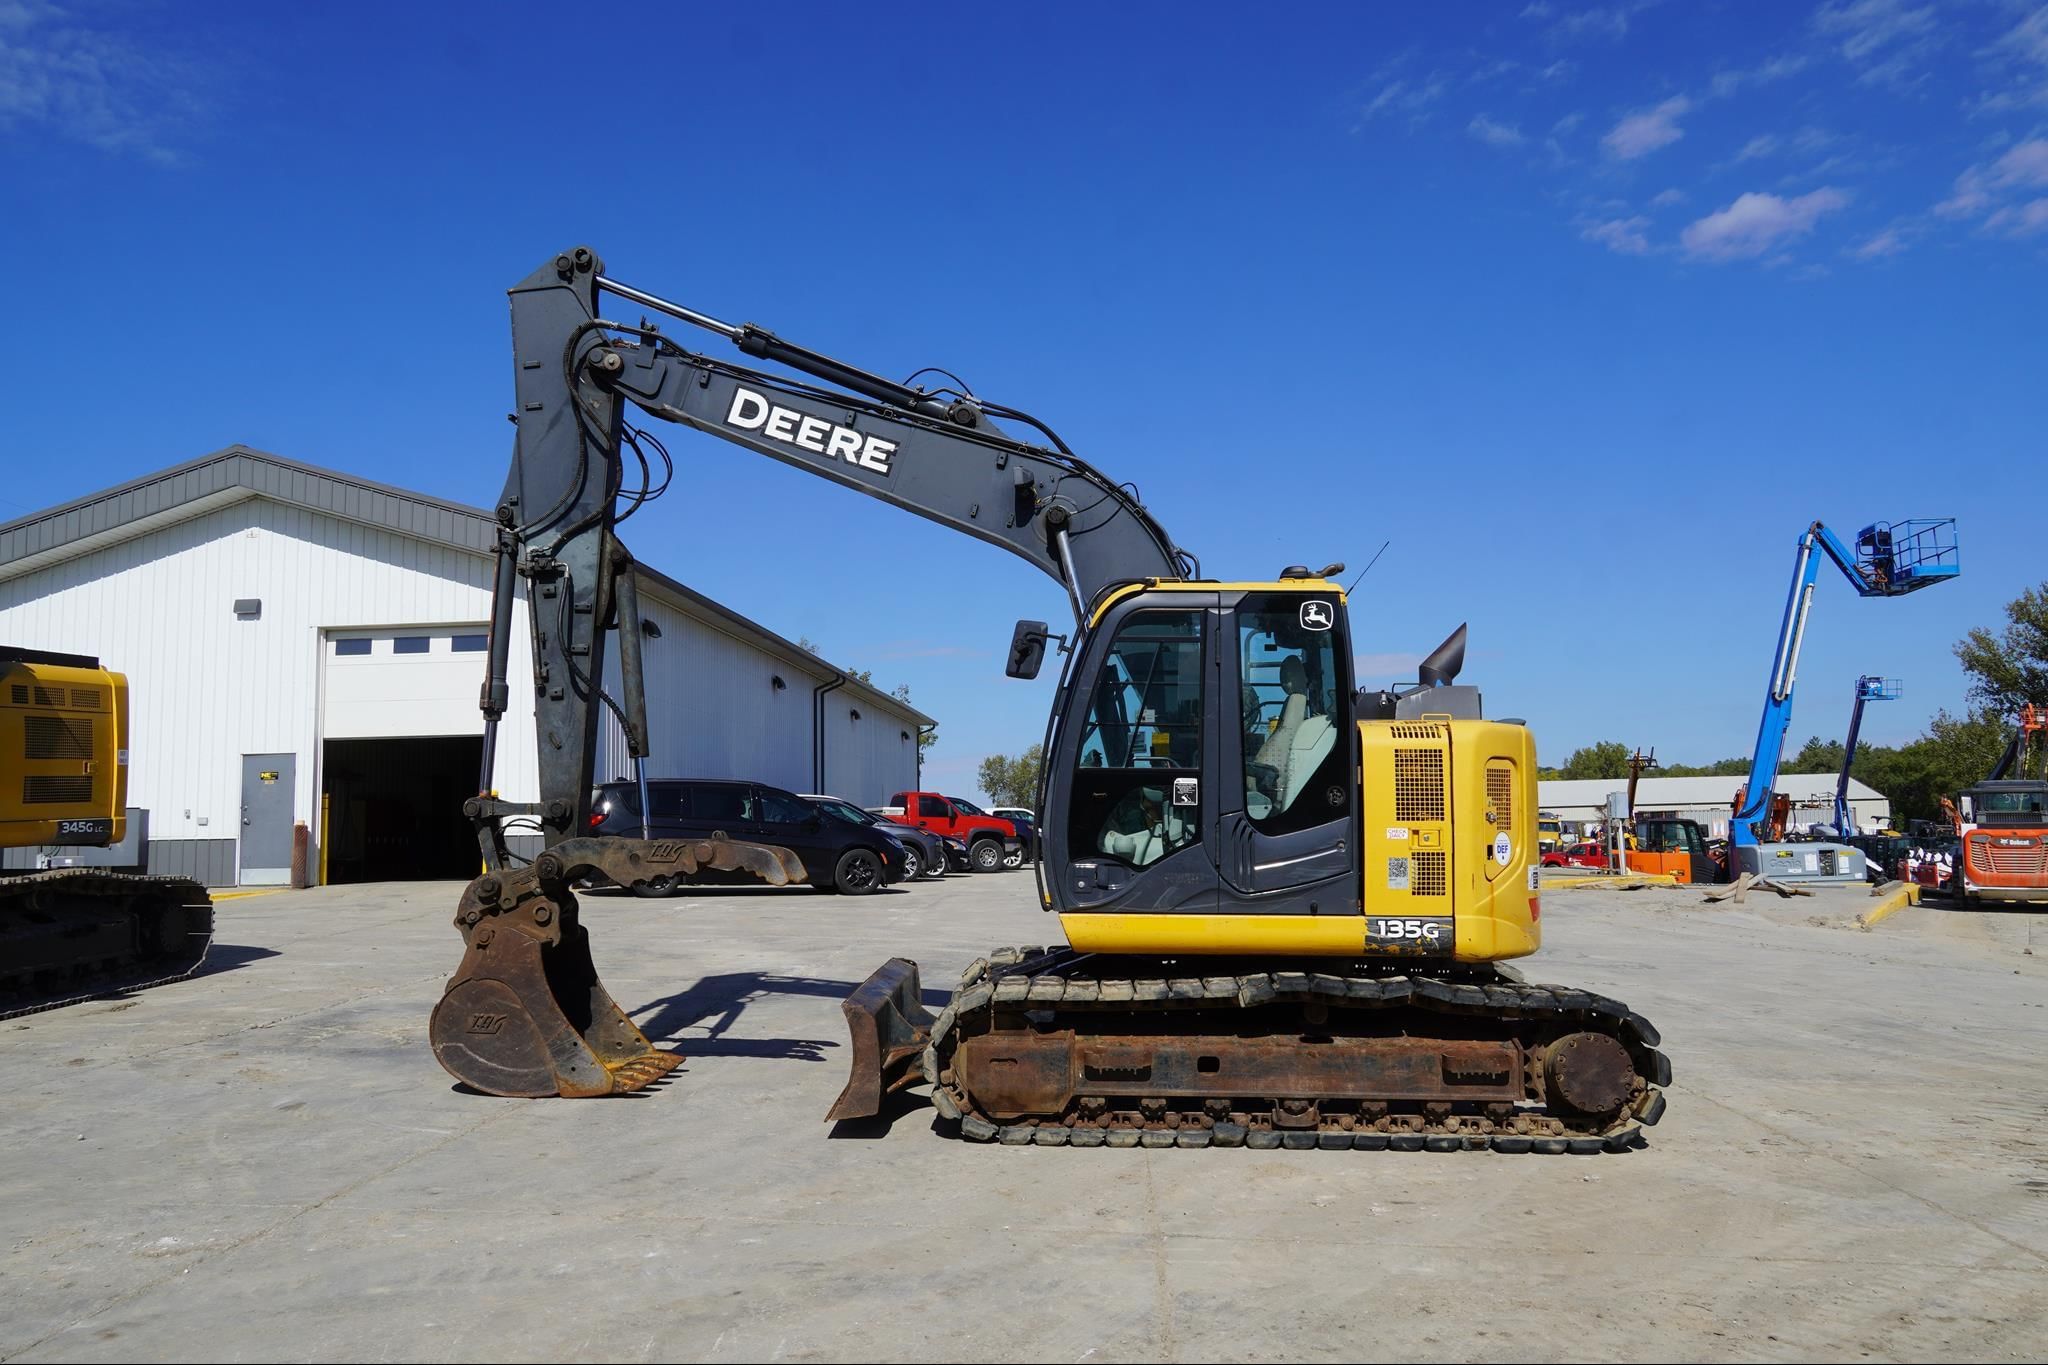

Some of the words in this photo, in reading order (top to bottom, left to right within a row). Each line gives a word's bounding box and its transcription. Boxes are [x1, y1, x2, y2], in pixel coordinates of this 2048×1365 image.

[727, 387, 897, 473] DEERE
[62, 821, 93, 833] 345G
[1496, 844, 1508, 854] DEF
[1377, 919, 1440, 939] 135G
